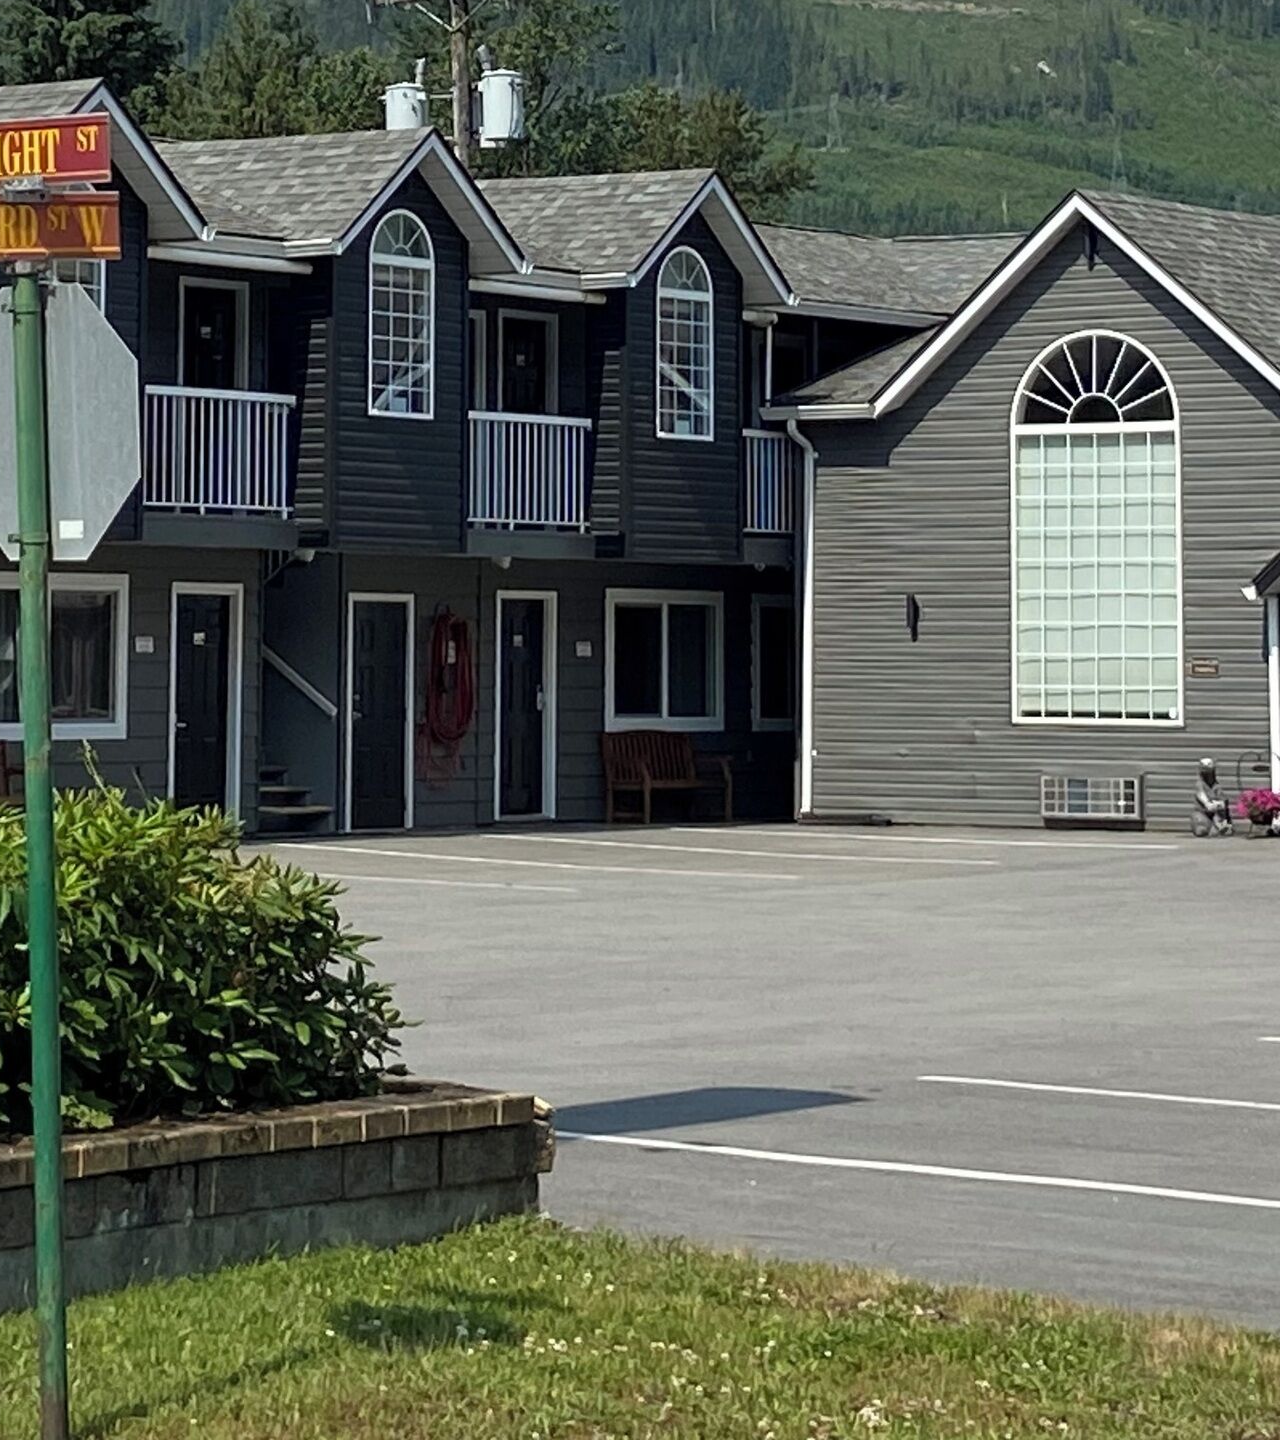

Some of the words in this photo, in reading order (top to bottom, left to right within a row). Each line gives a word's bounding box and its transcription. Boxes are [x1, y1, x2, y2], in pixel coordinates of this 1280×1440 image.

[76, 125, 99, 152] ST
[47, 205, 70, 231] ST
[74, 205, 108, 247] W
